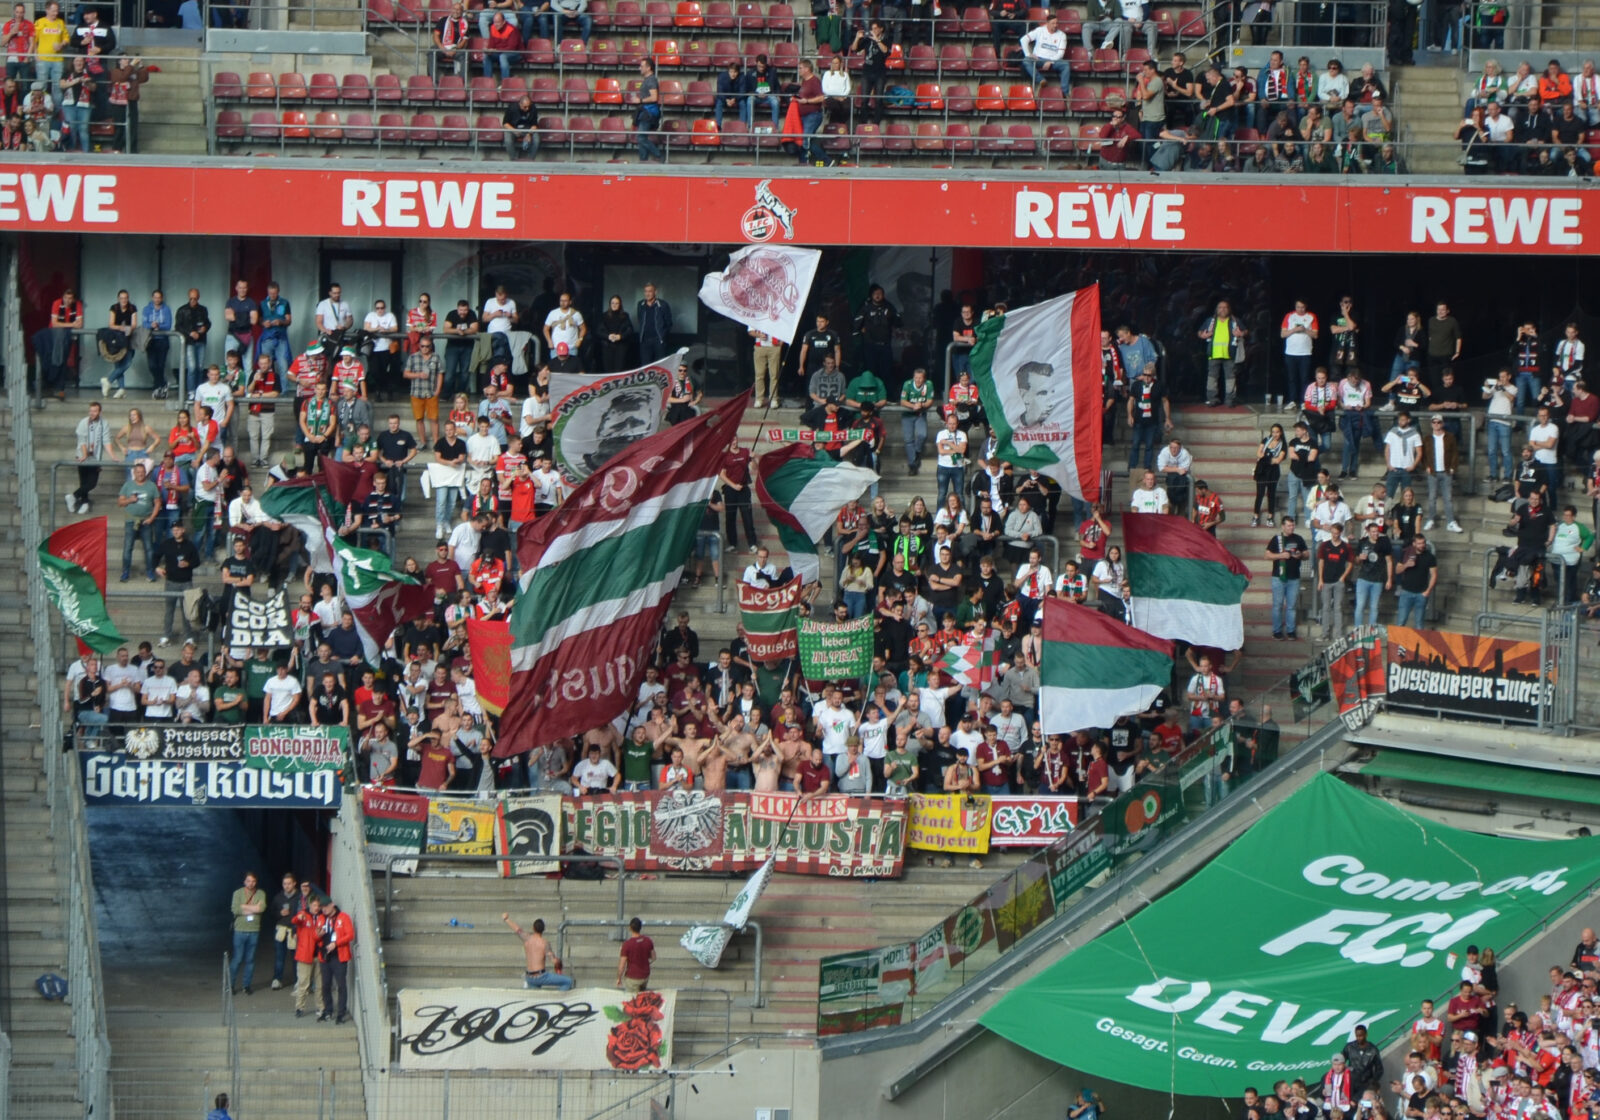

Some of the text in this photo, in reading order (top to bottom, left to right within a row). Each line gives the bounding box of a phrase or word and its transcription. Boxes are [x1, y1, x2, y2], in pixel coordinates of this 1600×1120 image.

[341, 179, 516, 230] REWE
[1015, 191, 1185, 240] REWE
[1411, 197, 1582, 245] REWE
[231, 608, 289, 629] COR
[230, 628, 291, 646] DIA
[745, 637, 796, 657] ugusta
[821, 637, 851, 647] lieben
[824, 666, 851, 677] leben
[249, 738, 342, 757] CONCORDIA
[751, 795, 848, 817] KICKERS
[912, 793, 952, 809] Frei
[561, 809, 902, 857] LEGIO AUGUSTA
[909, 830, 977, 848] Bayern
[853, 866, 892, 876] MMVII
[1303, 855, 1482, 900] Come
[1260, 908, 1499, 967] FC!
[1125, 976, 1400, 1046] DEVK
[401, 1000, 599, 1056] 1907
[1095, 1016, 1169, 1053] Gesagt.
[1177, 1046, 1238, 1069] Getan.
